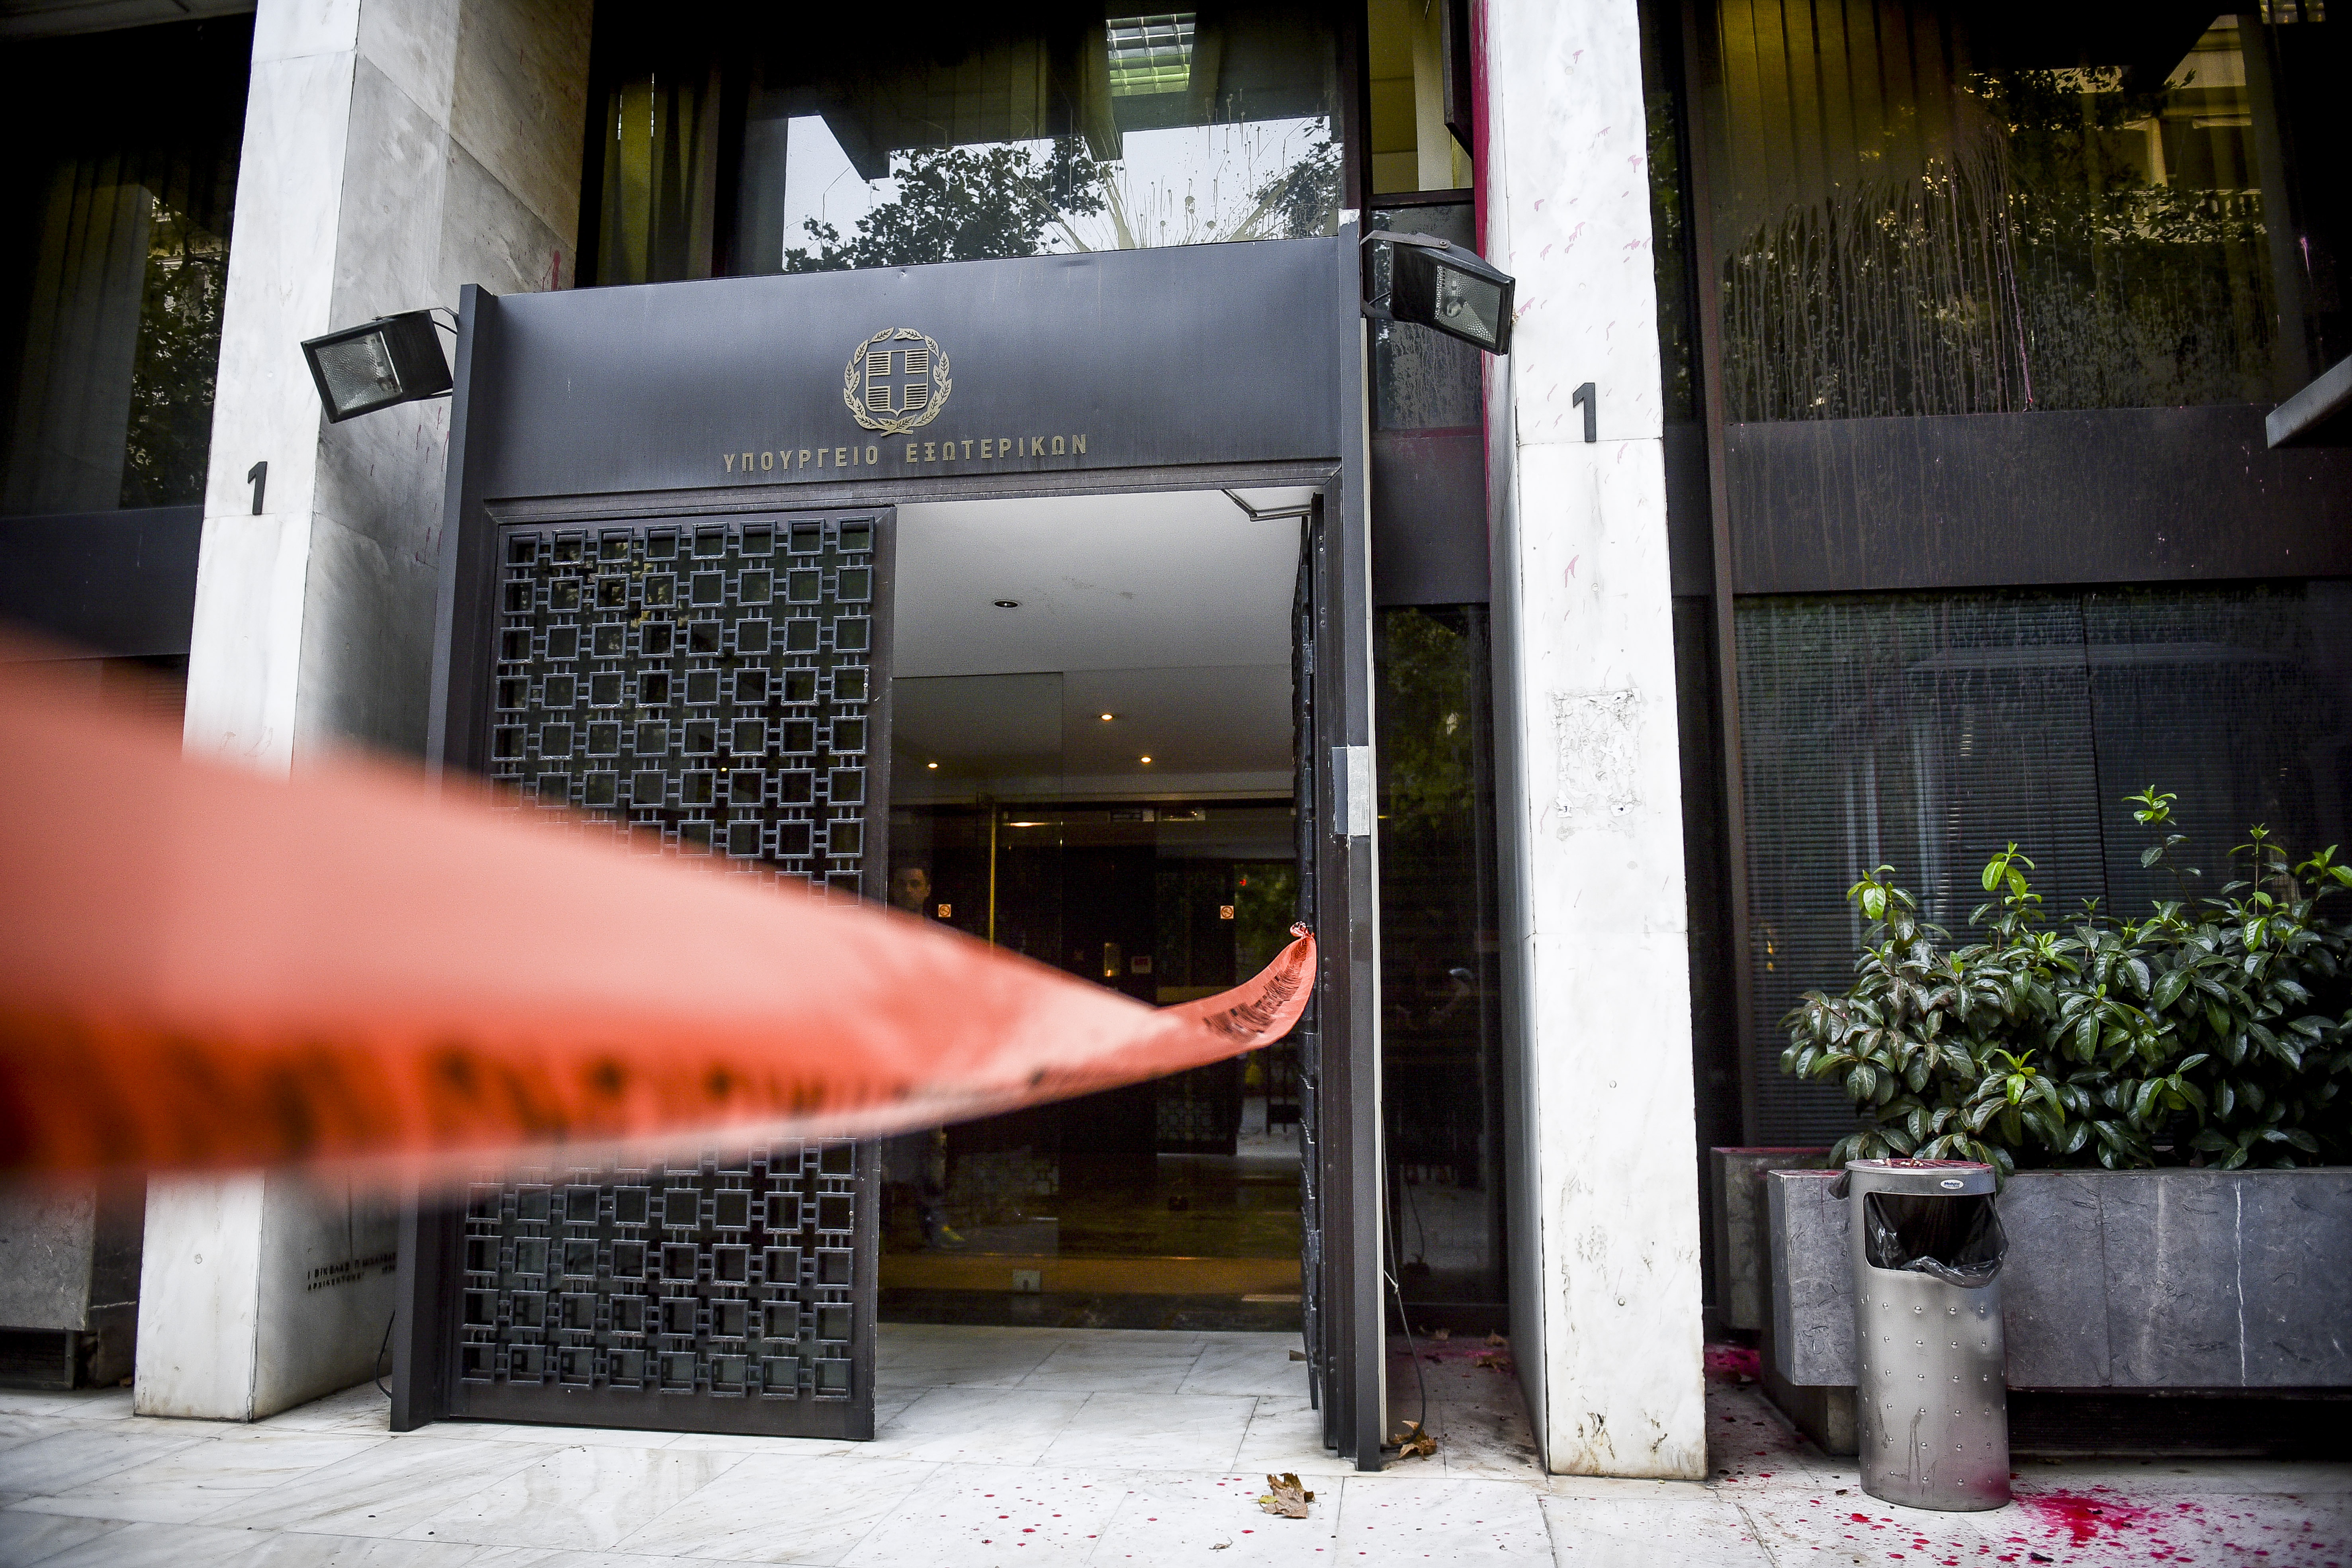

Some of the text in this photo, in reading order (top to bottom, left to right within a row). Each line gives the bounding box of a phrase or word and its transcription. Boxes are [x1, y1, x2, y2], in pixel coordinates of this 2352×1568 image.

[1573, 382, 1596, 442] 1
[723, 434, 1086, 473] ΥΠΟΥΡΓΕΙΟ ΕΞΩΤΕΡΙΚΩΝ
[247, 461, 268, 516] 1
